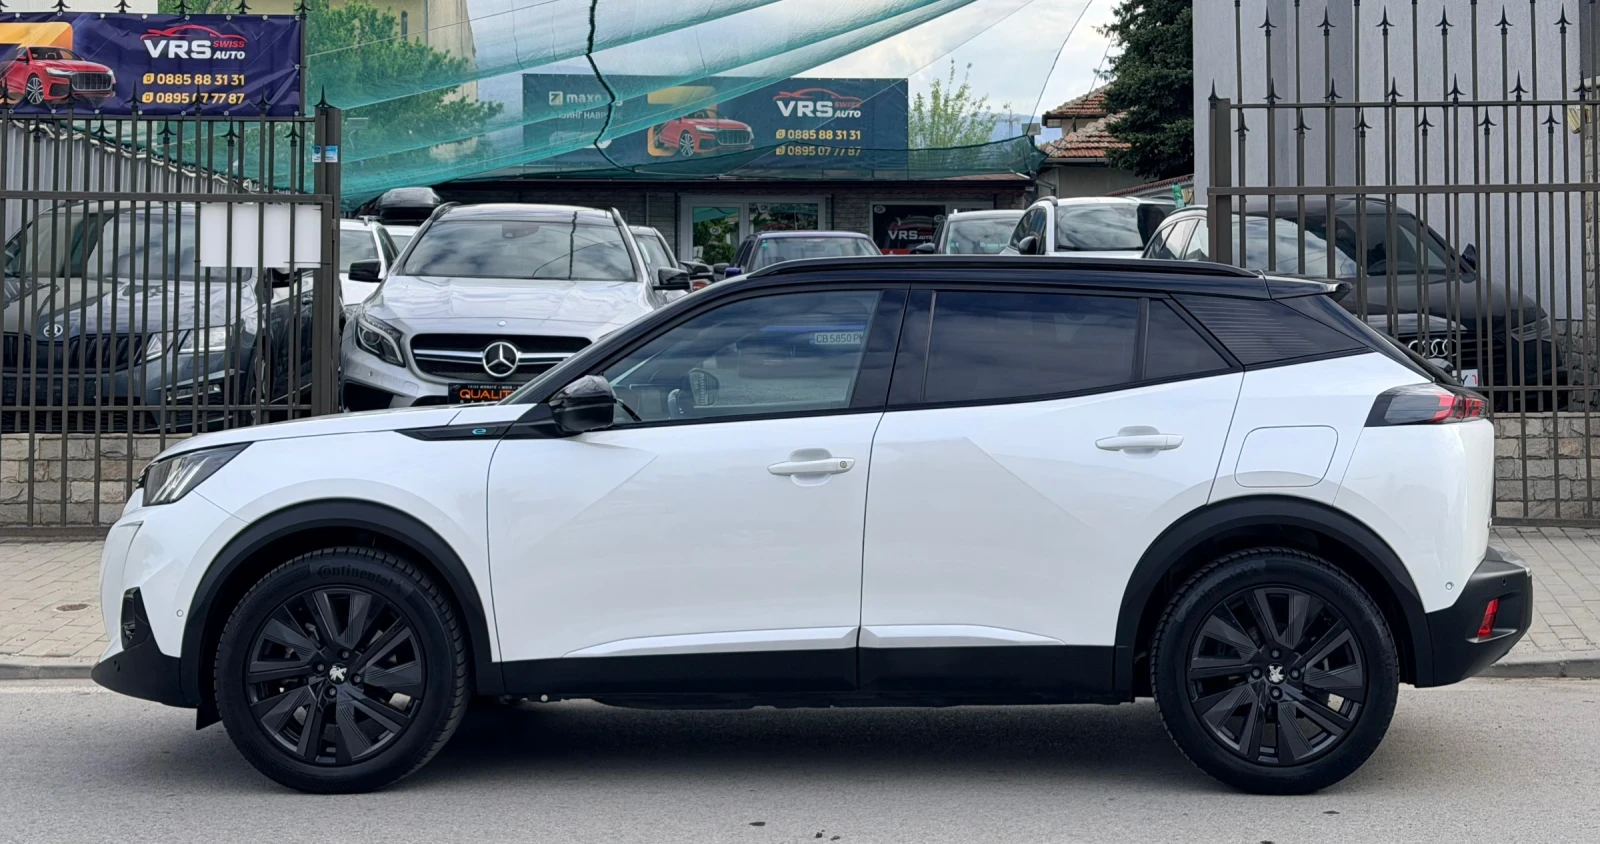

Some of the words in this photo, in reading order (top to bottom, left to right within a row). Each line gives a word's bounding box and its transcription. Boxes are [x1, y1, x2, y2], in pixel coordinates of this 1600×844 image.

[144, 39, 212, 59] VRS
[213, 40, 245, 48] SWISS
[213, 51, 246, 60] AUTO
[157, 74, 191, 85] 0885
[194, 74, 212, 86] 88
[214, 74, 229, 85] 31
[230, 74, 245, 86] 31
[156, 92, 190, 103] 0895
[211, 93, 227, 104] 77
[228, 93, 245, 104] 87
[776, 100, 833, 117] VRS
[834, 110, 862, 118] AUTO
[787, 129, 817, 140] 0885
[818, 129, 834, 140] 88
[835, 130, 847, 140] 31
[849, 130, 861, 140] 31
[787, 145, 816, 156] 0895
[817, 146, 832, 156] 07
[888, 230, 918, 240] VRS
[816, 334, 829, 343] CB
[829, 333, 852, 343] 5850
[459, 388, 515, 399] QUALIT
[317, 563, 395, 588] Continental
